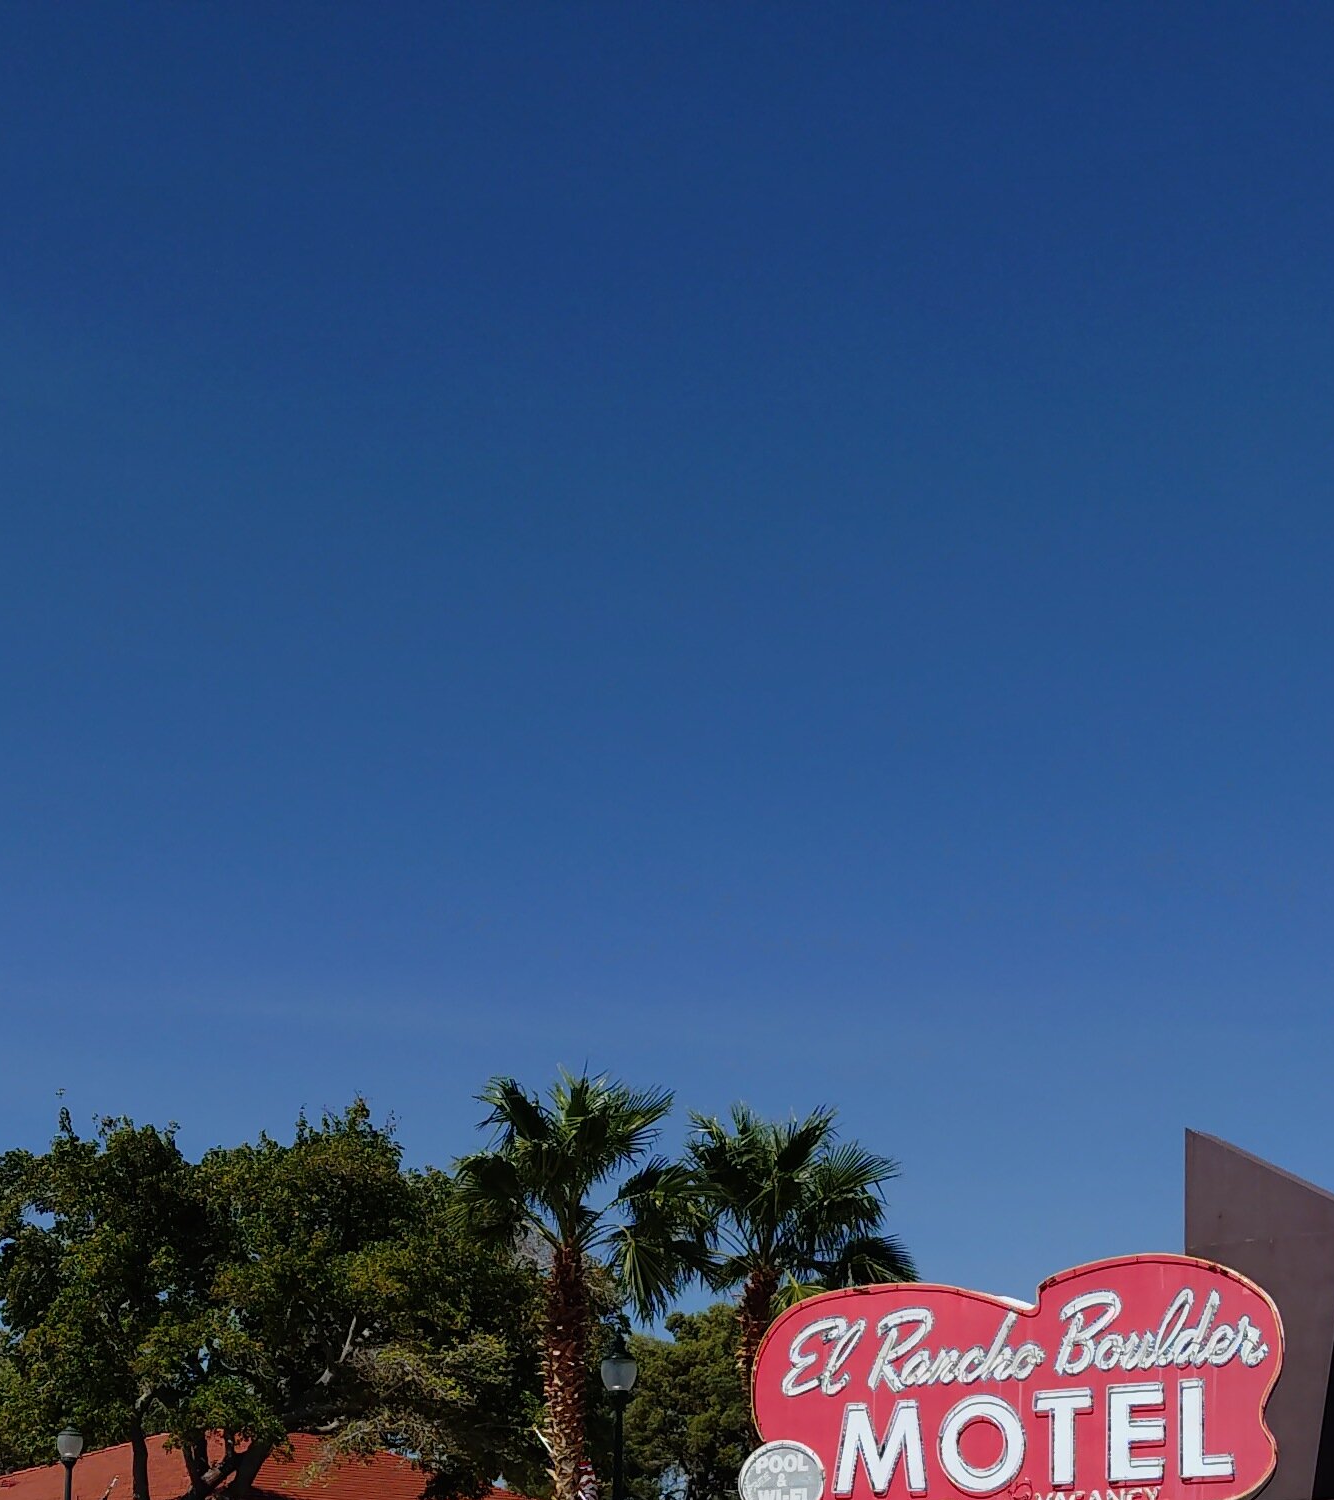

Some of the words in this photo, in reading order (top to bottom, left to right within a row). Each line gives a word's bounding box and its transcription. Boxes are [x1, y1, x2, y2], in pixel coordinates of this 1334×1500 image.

[781, 1316, 866, 1397] El
[868, 1306, 1046, 1393] Rancho
[1054, 1287, 1269, 1376] Boulder
[755, 1453, 809, 1474] POOL
[831, 1378, 1235, 1496] MOTEL
[776, 1473, 788, 1488] &
